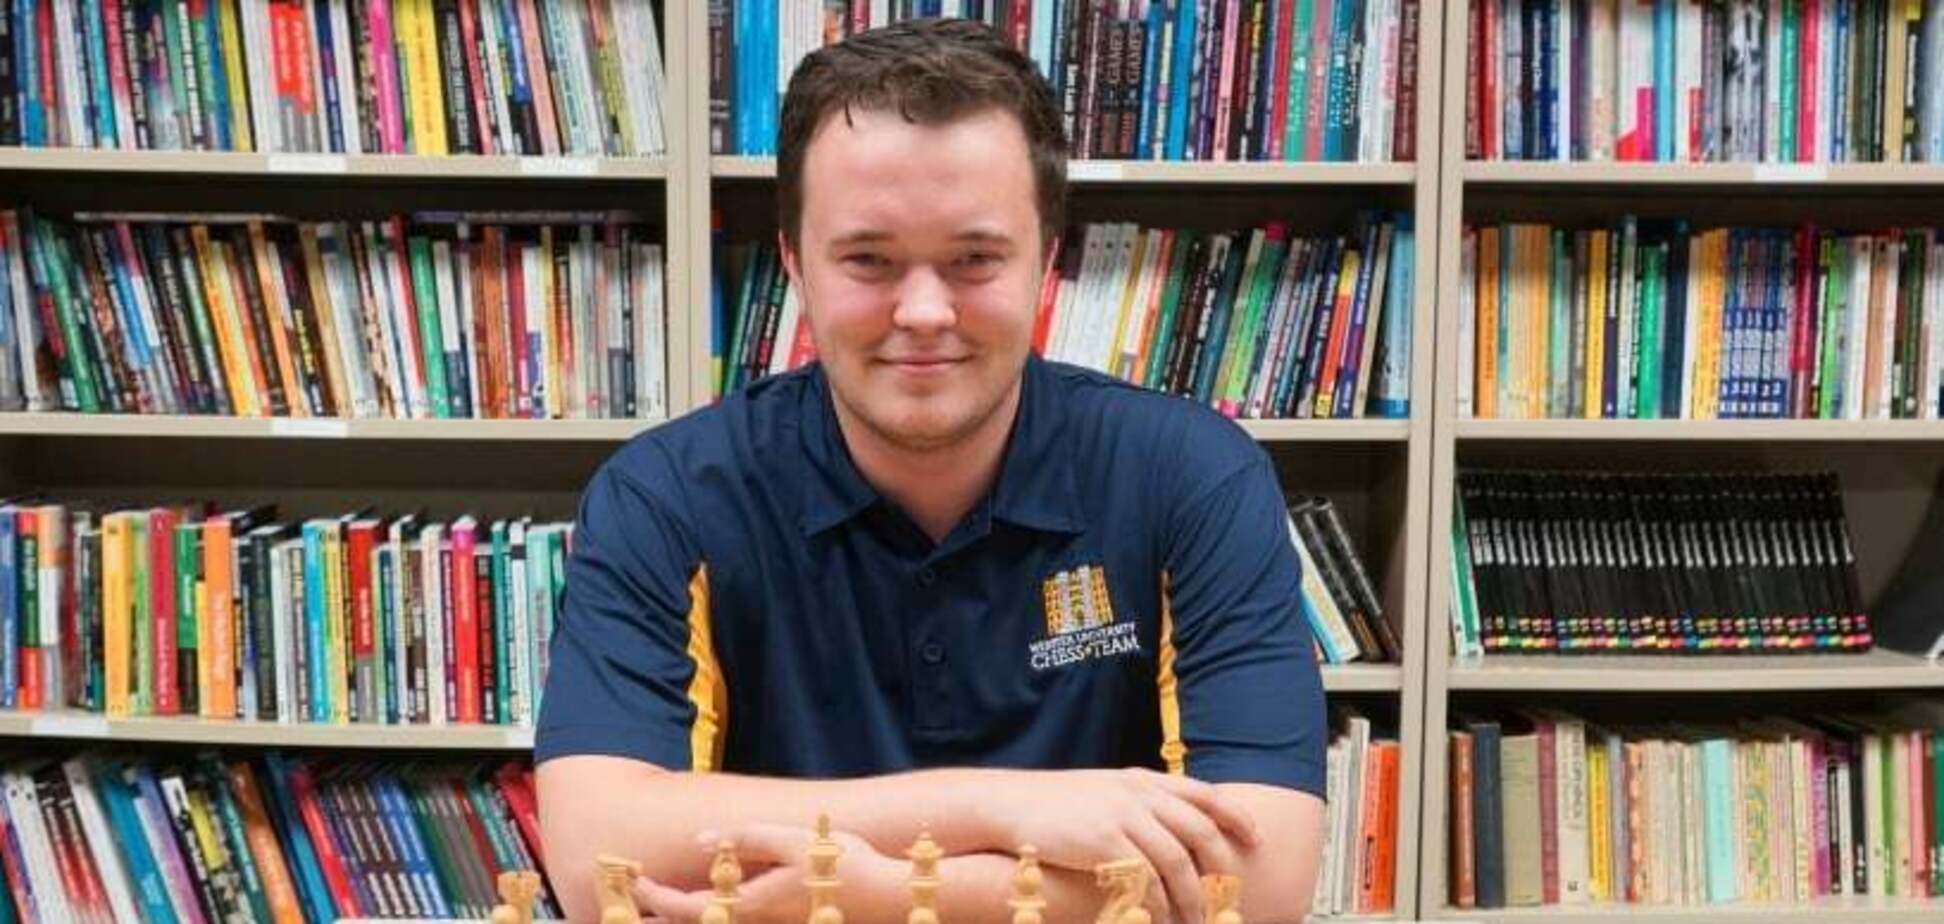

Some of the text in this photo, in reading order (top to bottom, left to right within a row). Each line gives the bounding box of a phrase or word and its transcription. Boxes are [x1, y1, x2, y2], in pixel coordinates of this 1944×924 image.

[1076, 621, 1136, 643] UNIVERSITY
[1030, 635, 1141, 670] CHESS TEAM
